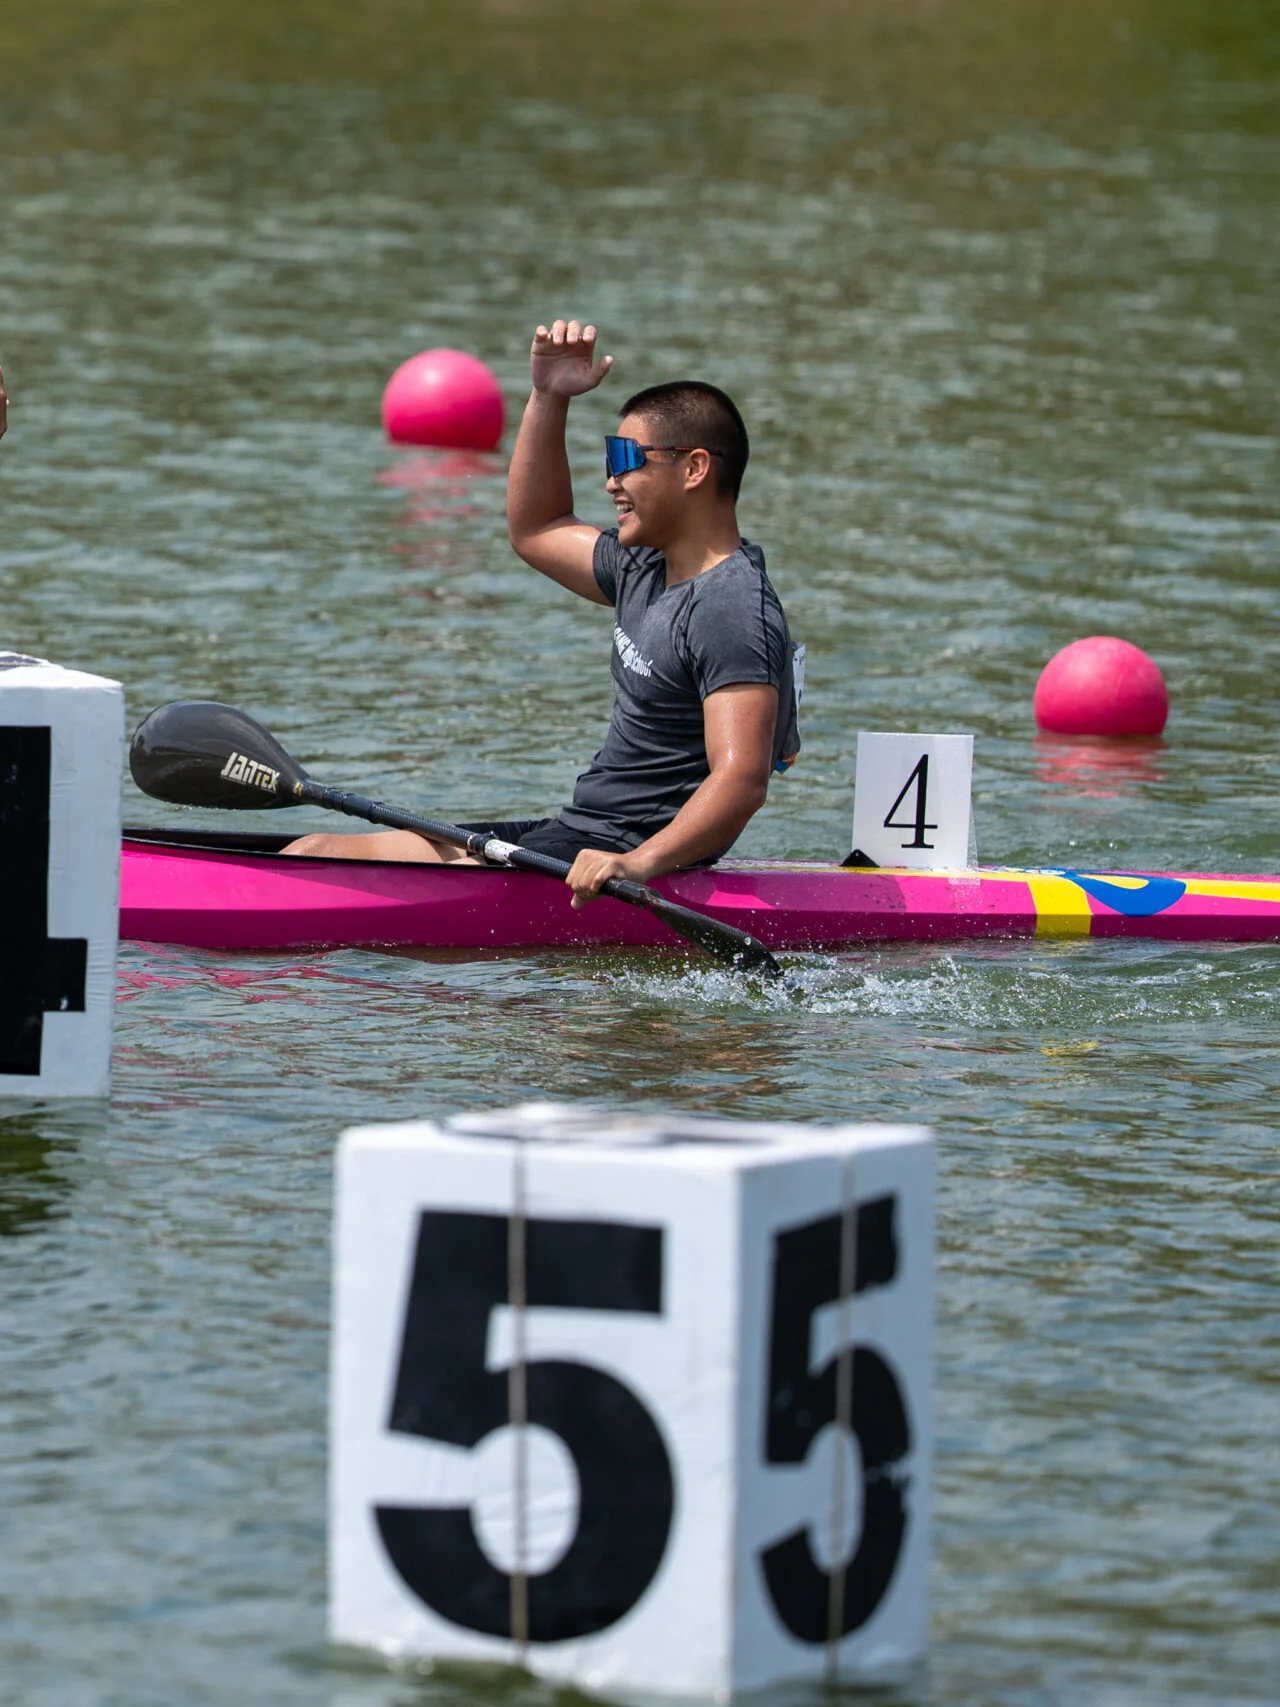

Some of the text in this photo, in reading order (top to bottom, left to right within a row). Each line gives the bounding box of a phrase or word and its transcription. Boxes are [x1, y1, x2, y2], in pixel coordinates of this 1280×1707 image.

[883, 753, 939, 849] 4
[374, 1208, 675, 1643] 5
[760, 1194, 912, 1645] 5
